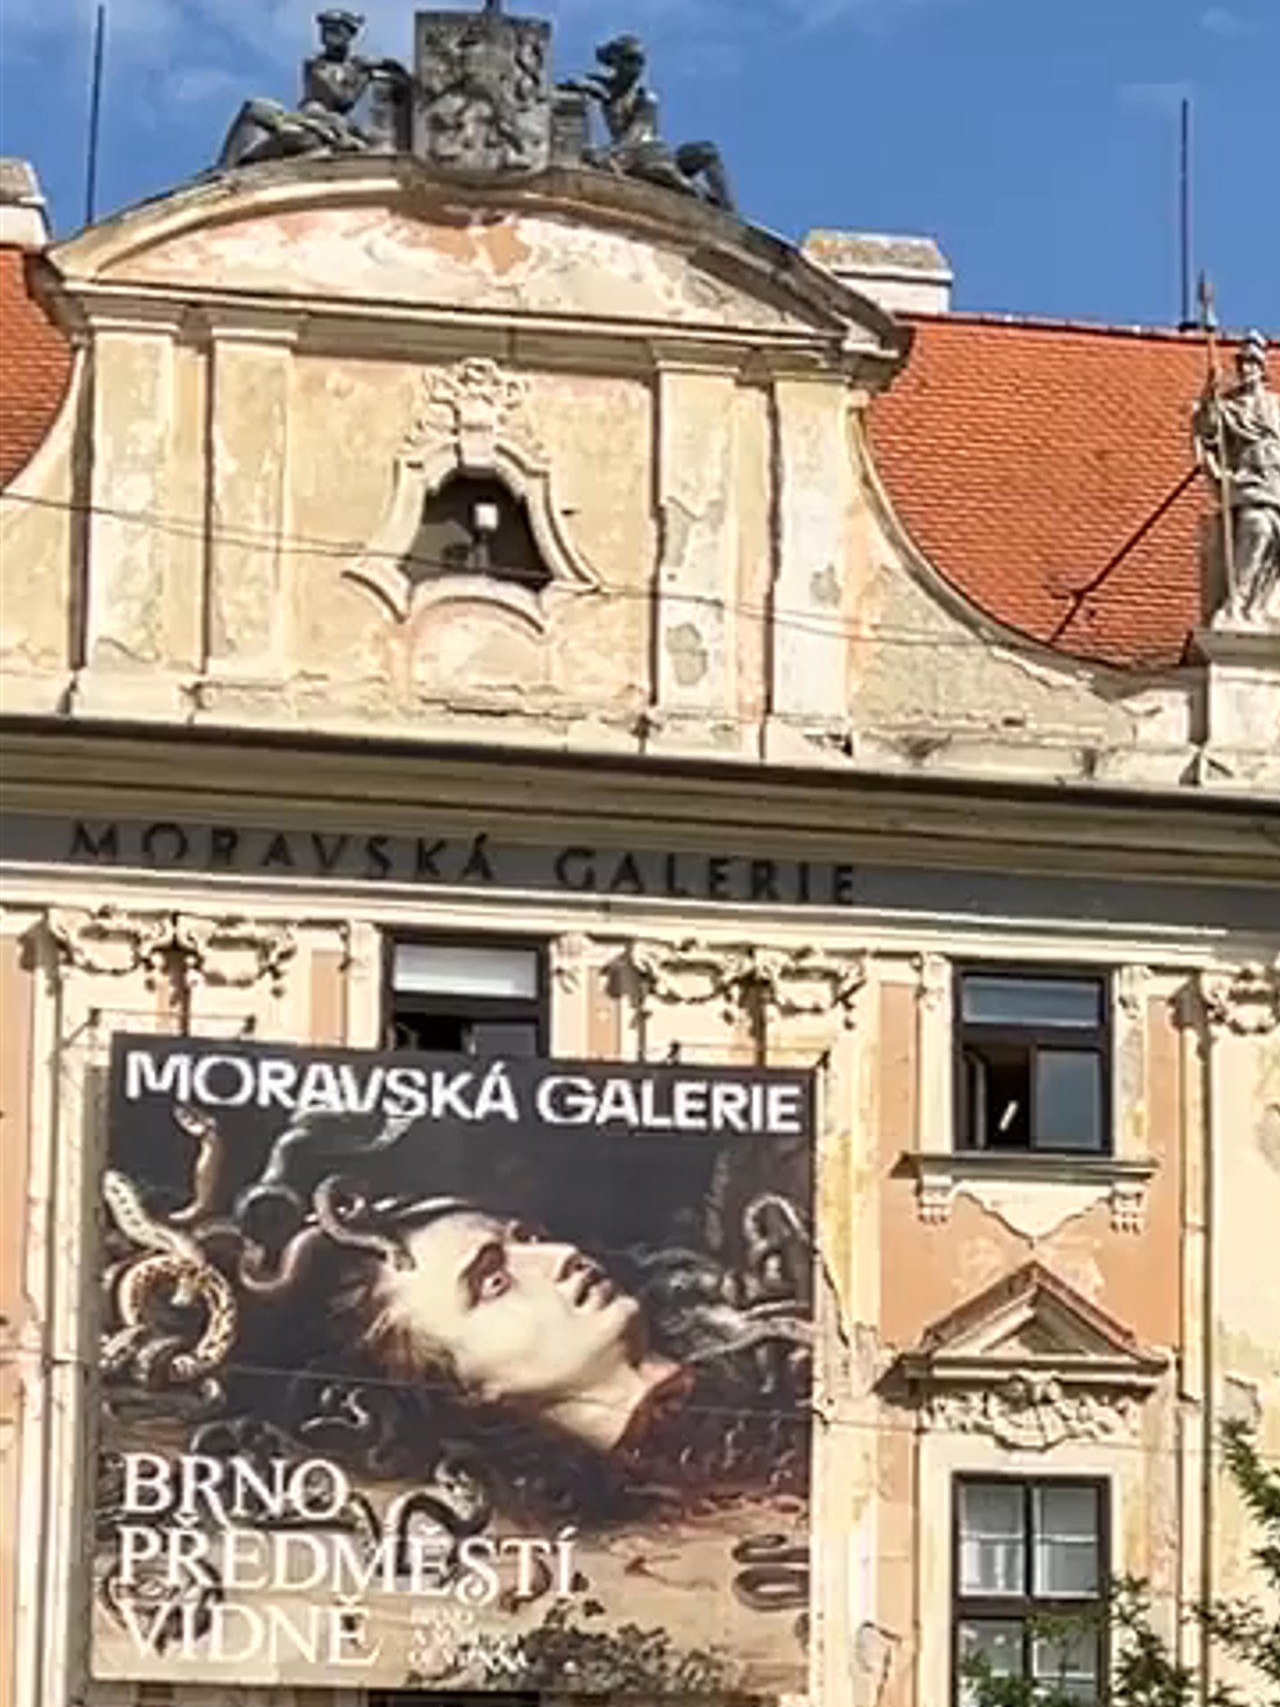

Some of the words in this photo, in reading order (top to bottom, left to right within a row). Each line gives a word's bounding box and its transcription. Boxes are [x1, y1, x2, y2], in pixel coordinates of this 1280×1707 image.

[69, 821, 494, 881] MORAVSKÁ
[554, 845, 856, 905] GALERIE
[125, 1049, 519, 1122] MORAVSKÁ
[536, 1075, 802, 1134] GALERIE
[121, 1451, 350, 1527] BRNO
[116, 1513, 579, 1607] PŘEDMĚSTÍ
[114, 1591, 381, 1667] VÍDNĚ
